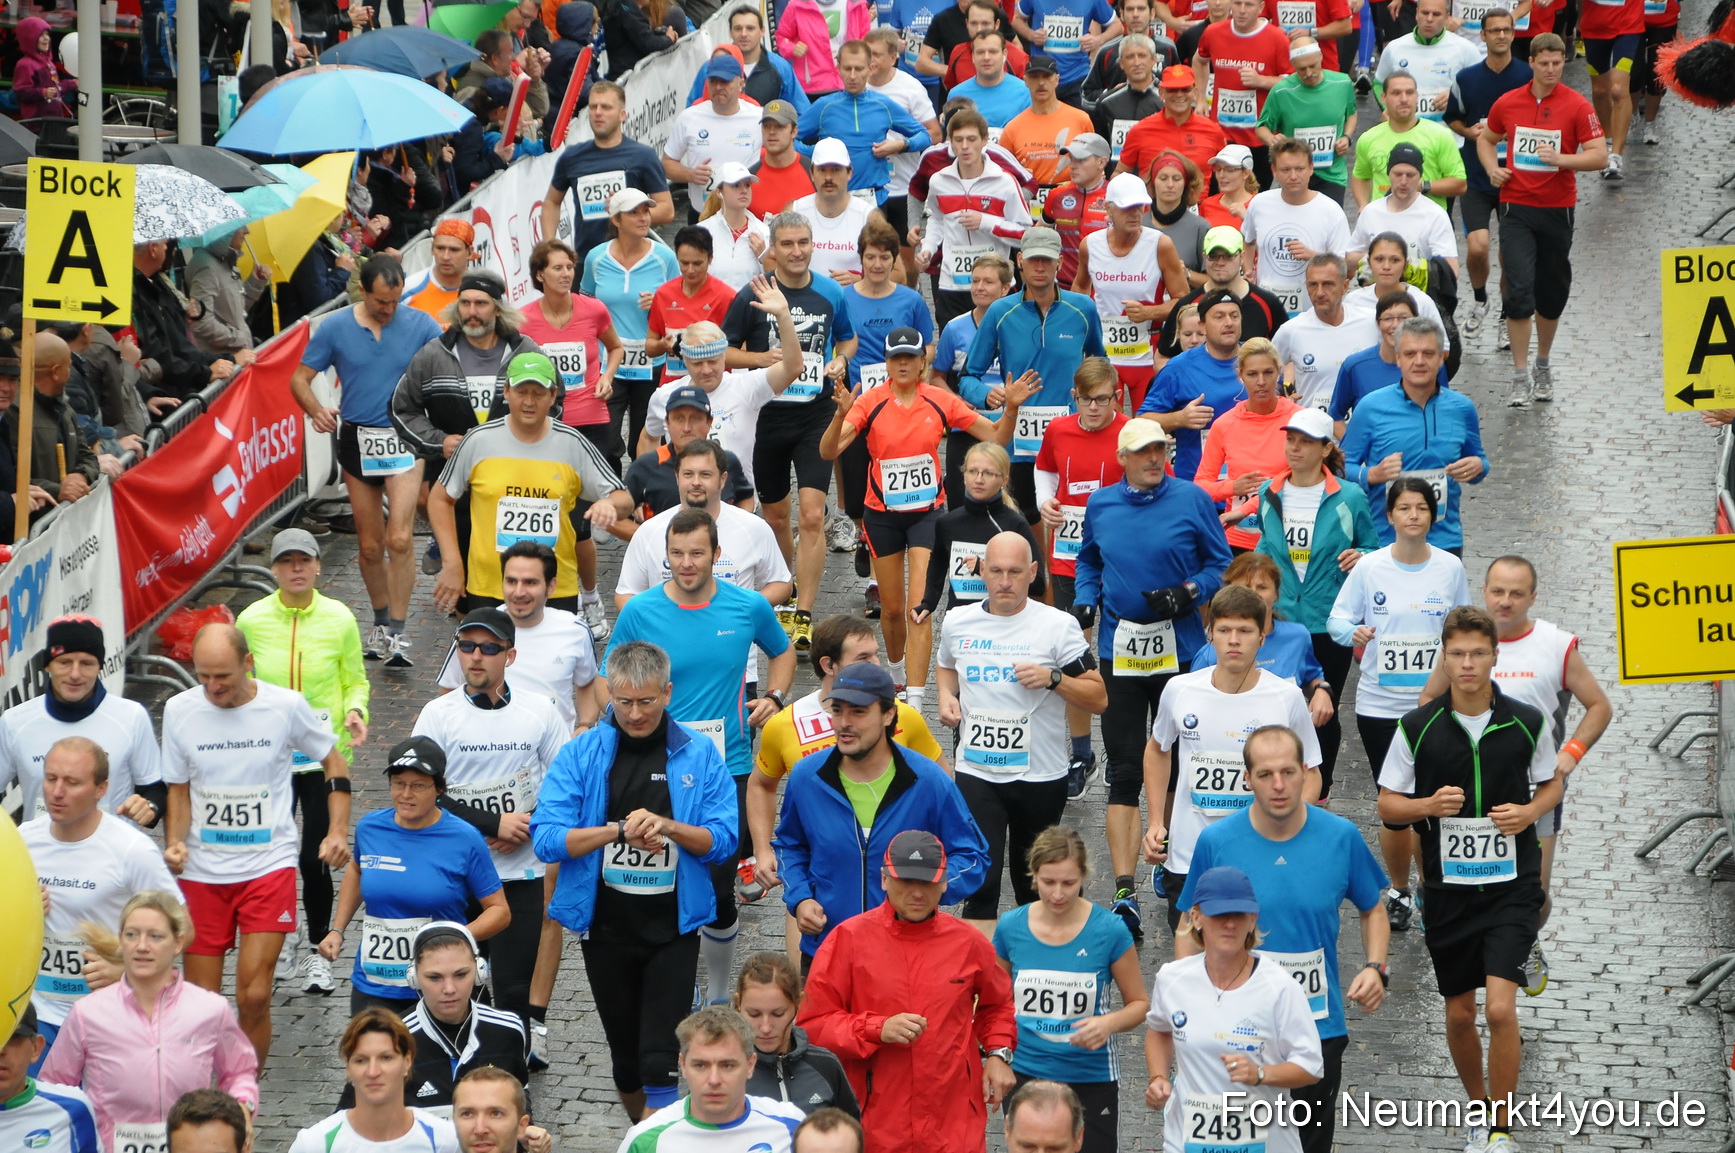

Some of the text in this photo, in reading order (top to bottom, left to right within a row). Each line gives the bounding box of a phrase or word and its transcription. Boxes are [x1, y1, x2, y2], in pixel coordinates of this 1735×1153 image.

[1281, 11, 1313, 25] 2280
[1047, 24, 1080, 39] 2084
[1221, 98, 1253, 114] 2376
[38, 164, 123, 198] Block
[583, 181, 622, 202] 2539
[46, 209, 108, 288] A
[1095, 271, 1148, 282] Oberbank
[790, 306, 806, 315] 40.
[1108, 326, 1139, 344] 389
[1686, 295, 1735, 375] A
[1113, 346, 1136, 355] Martin
[787, 386, 806, 395] Mark
[901, 459, 926, 469] Neumarkt
[887, 466, 932, 492] 2756
[505, 485, 550, 500] FRANK
[904, 493, 921, 503] Jina
[521, 502, 550, 511] Neumarkt
[503, 510, 554, 534] 2266
[1285, 526, 1309, 548] 49
[1630, 579, 1734, 609] Schnu
[1134, 626, 1164, 636] Neumarkt
[958, 639, 993, 650] TEAM
[1126, 635, 1165, 656] 478
[1127, 658, 1164, 669] Siegfried
[1384, 648, 1438, 671] 3147
[987, 716, 1019, 725] Neumarkt
[969, 723, 1024, 750] 2552
[196, 737, 271, 752] www.hasit.de
[459, 741, 532, 753] www.hasit.de
[983, 753, 1007, 766] Josef
[1190, 755, 1215, 765] PARTL
[222, 791, 259, 800] Neumarkt
[471, 783, 506, 796] Neumarkt
[1200, 796, 1248, 808] Alexander
[205, 801, 263, 828] 2451
[1441, 823, 1463, 831] PARTL
[215, 831, 255, 844] Manfred
[1447, 833, 1508, 859] 2876
[611, 842, 670, 868] 2521
[1456, 864, 1501, 877] Christoph
[622, 872, 659, 885] Werner
[385, 924, 419, 933] Neumarkt
[40, 949, 87, 977] 245
[1279, 959, 1316, 968] Neumarkt
[52, 980, 85, 993] Stefan
[1044, 978, 1083, 988] Neumarkt
[1022, 987, 1088, 1016] 2619
[1035, 1020, 1071, 1033] Sandra
[1192, 1112, 1257, 1141] 2431
